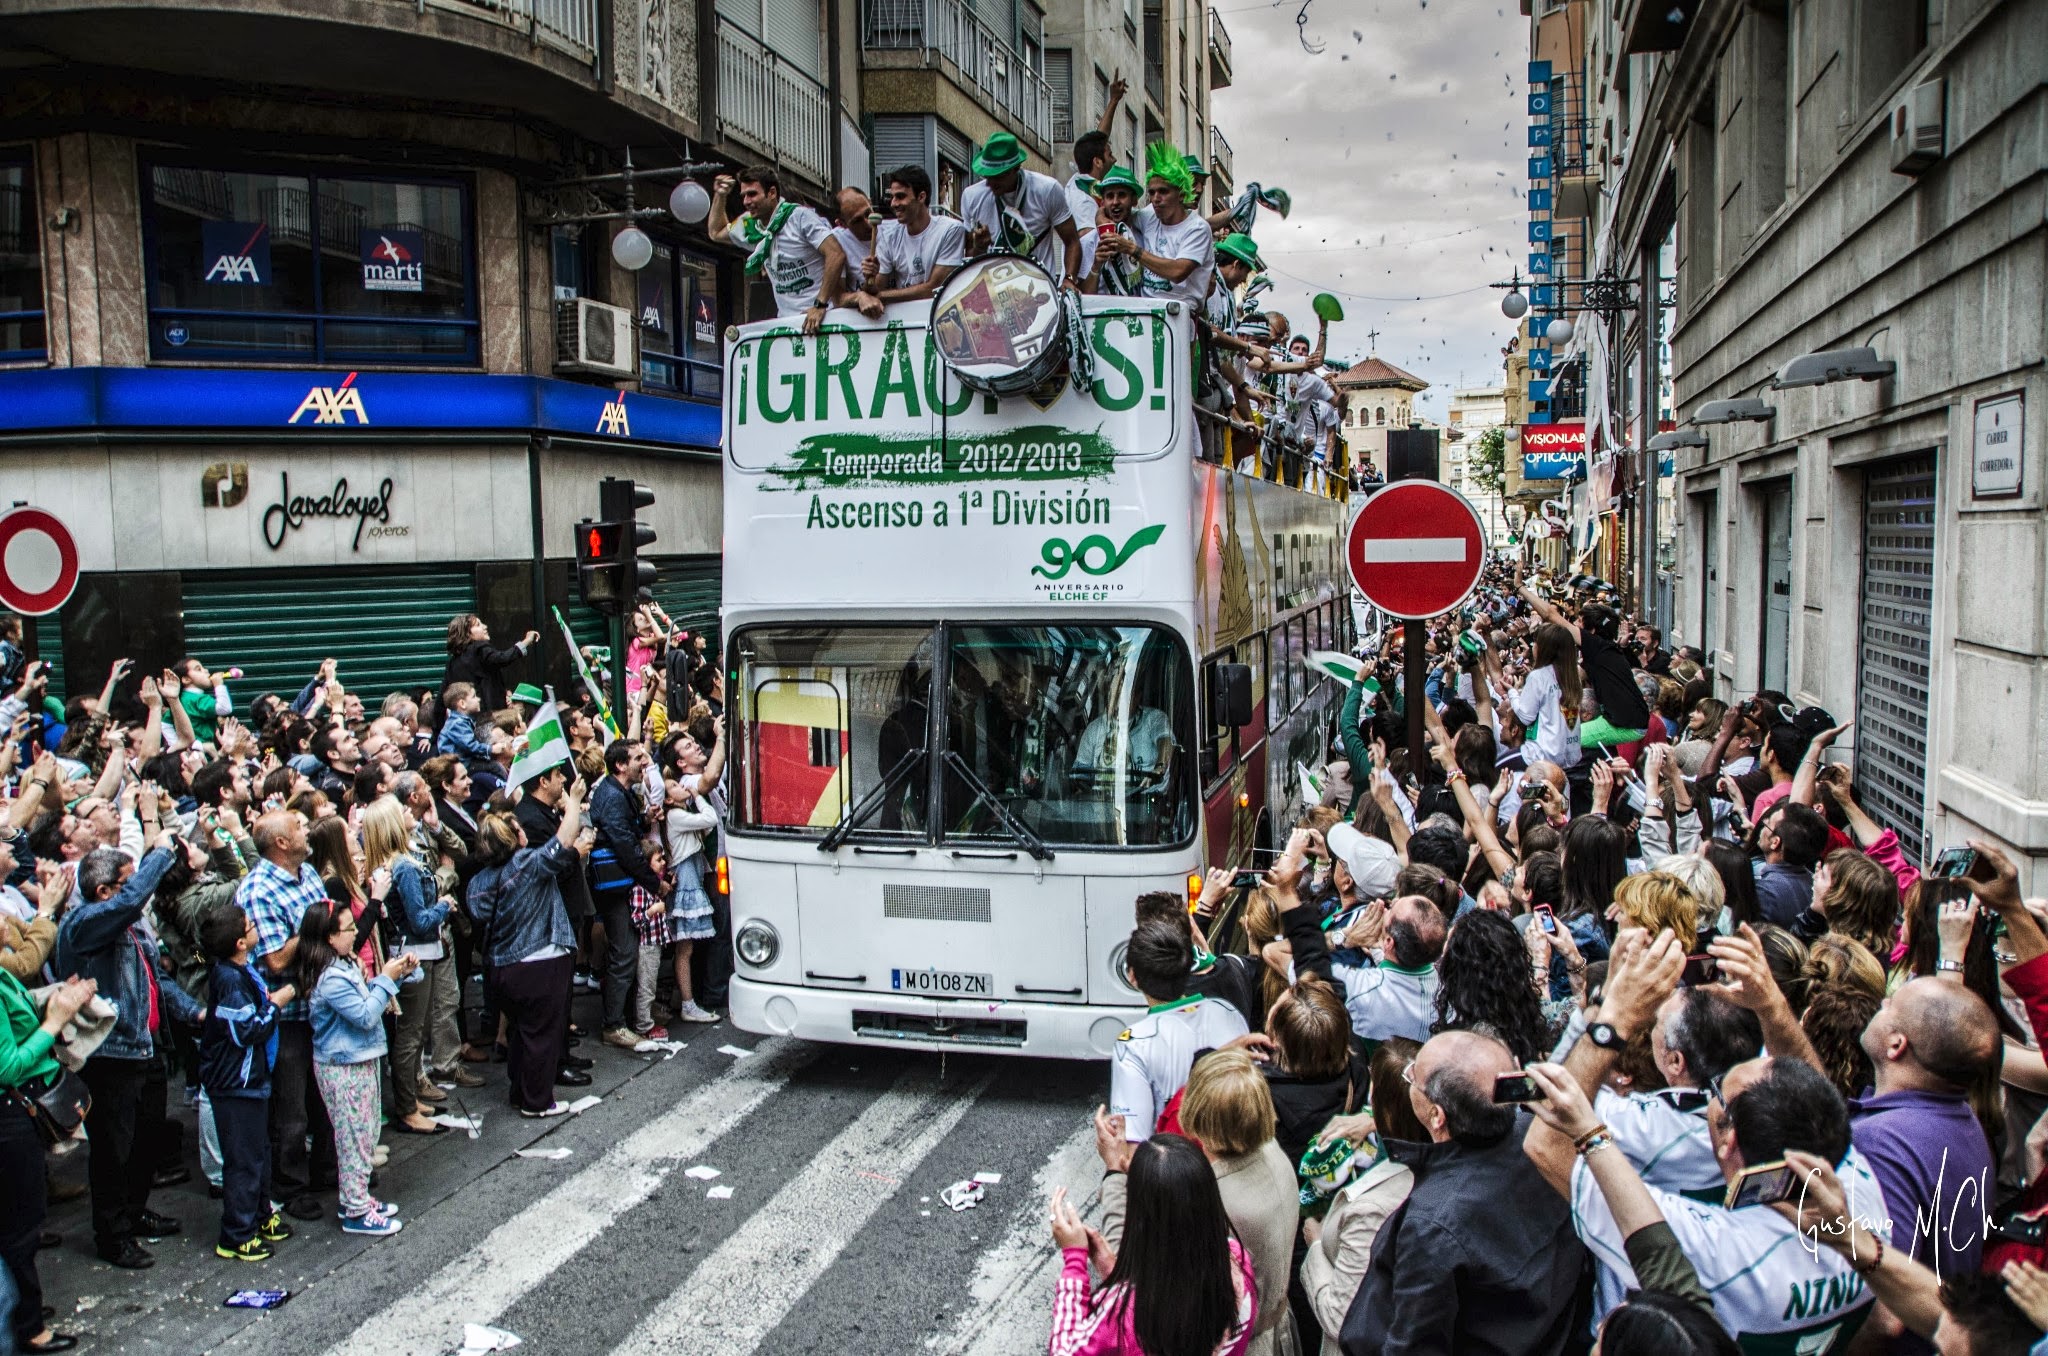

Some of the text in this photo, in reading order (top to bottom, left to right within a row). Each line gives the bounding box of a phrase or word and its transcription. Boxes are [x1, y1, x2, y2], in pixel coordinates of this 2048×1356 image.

[1532, 98, 1545, 364] OPTICALIA
[205, 255, 260, 282] AXA
[364, 262, 421, 280] martí
[641, 306, 660, 329] AXA
[288, 387, 369, 424] AXA
[596, 402, 630, 436] AXA
[1524, 434, 1586, 444] VISIONLAB
[1986, 431, 2008, 446] CARRER
[822, 443, 1081, 479] Temporada 2012/2013
[1980, 458, 2014, 473] CORREDORA
[807, 494, 922, 529] Ascenso
[933, 501, 948, 527] a
[992, 489, 1110, 526] División
[366, 525, 409, 538] joyeros
[1050, 592, 1108, 601] ELCHE CF
